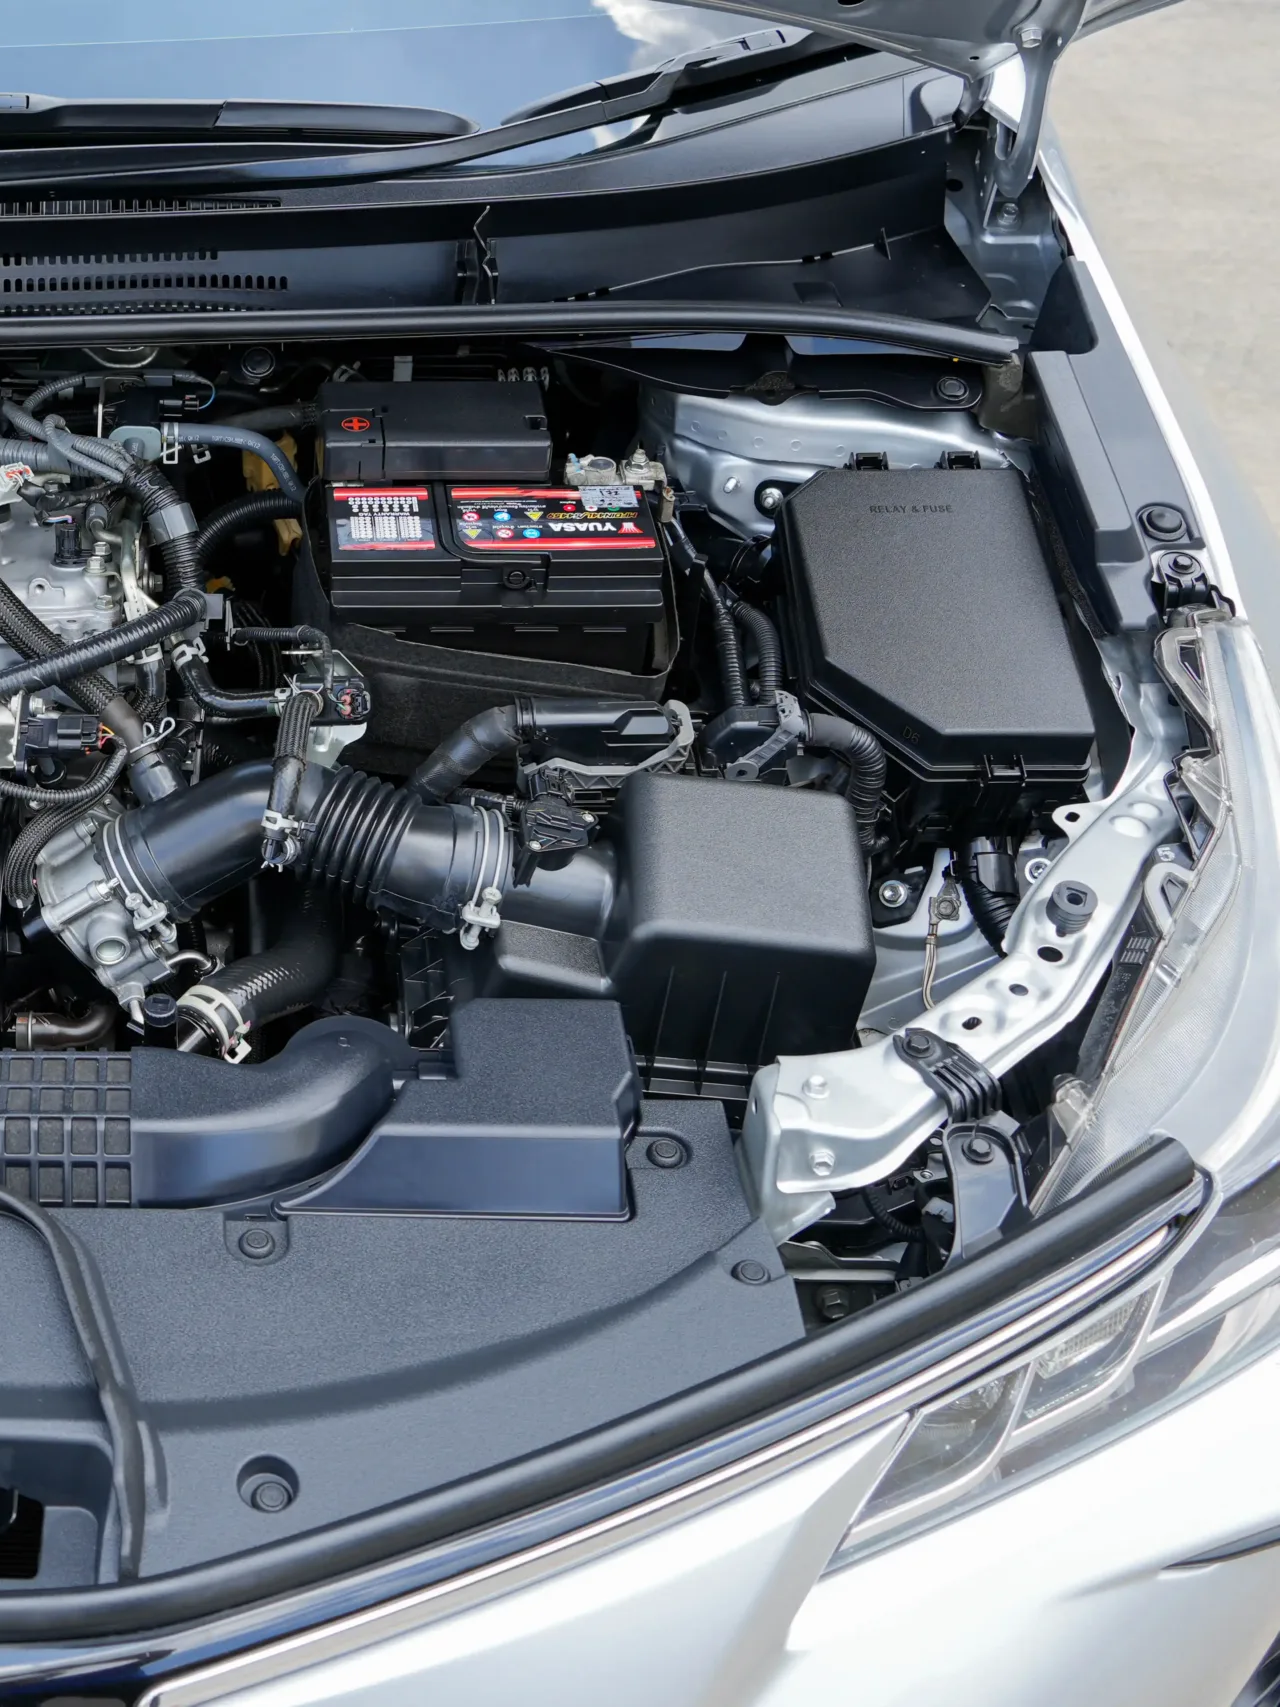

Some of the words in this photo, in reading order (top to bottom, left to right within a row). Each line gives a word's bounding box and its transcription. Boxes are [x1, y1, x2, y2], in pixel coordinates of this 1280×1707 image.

[869, 505, 906, 513] RELAY
[911, 505, 920, 513] &
[922, 505, 953, 513] FUSE
[547, 522, 618, 532] YUASA
